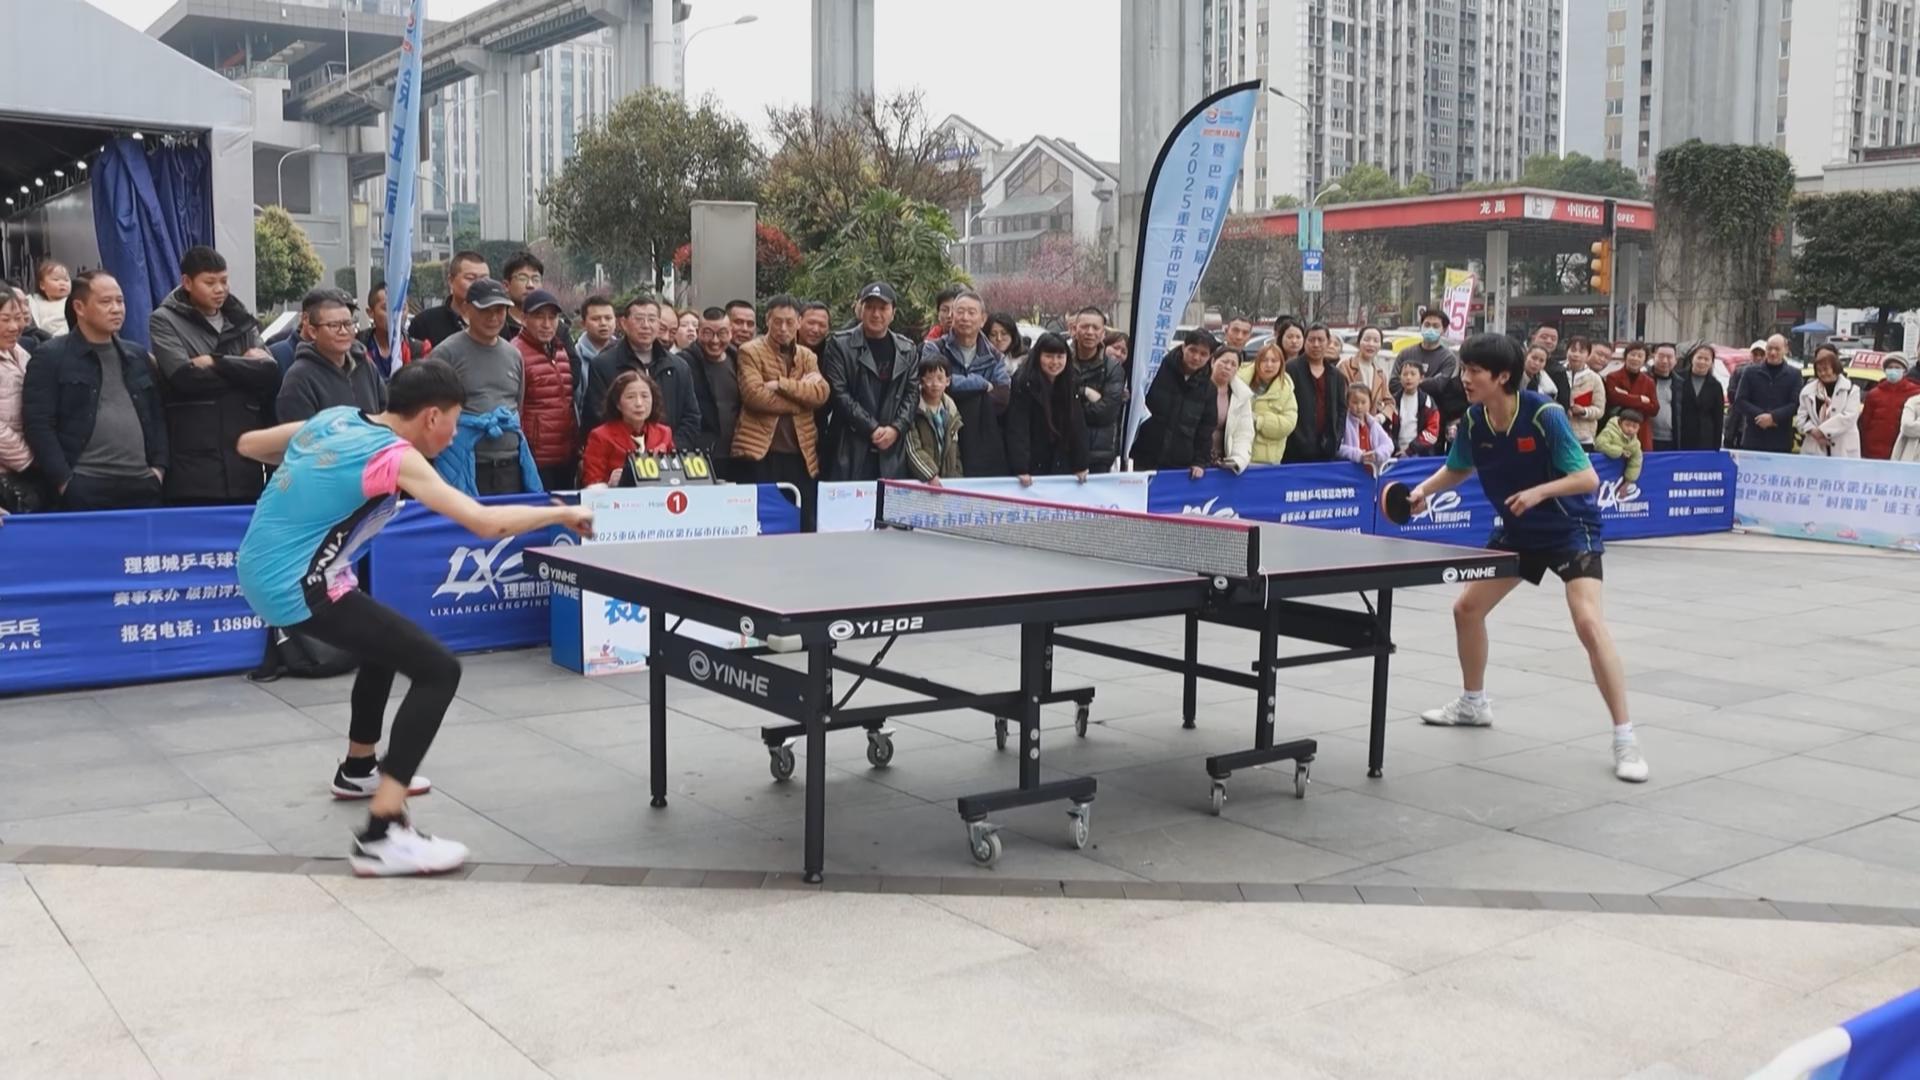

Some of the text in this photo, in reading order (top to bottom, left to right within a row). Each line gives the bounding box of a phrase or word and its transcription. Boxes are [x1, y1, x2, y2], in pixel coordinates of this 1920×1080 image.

[1567, 202, 1600, 219] 中国石化
[634, 457, 659, 479] 10
[683, 456, 708, 477] 10
[1736, 472, 1920, 501] 2025重庆市巴南区第五届市民
[124, 551, 241, 575] 理想城乒乓球
[306, 530, 349, 586] YINE
[550, 567, 578, 585] YINHE
[1459, 566, 1497, 581] YINHE
[212, 615, 271, 633] 13896
[856, 616, 924, 636] Y1202
[712, 663, 770, 697] YINHE
